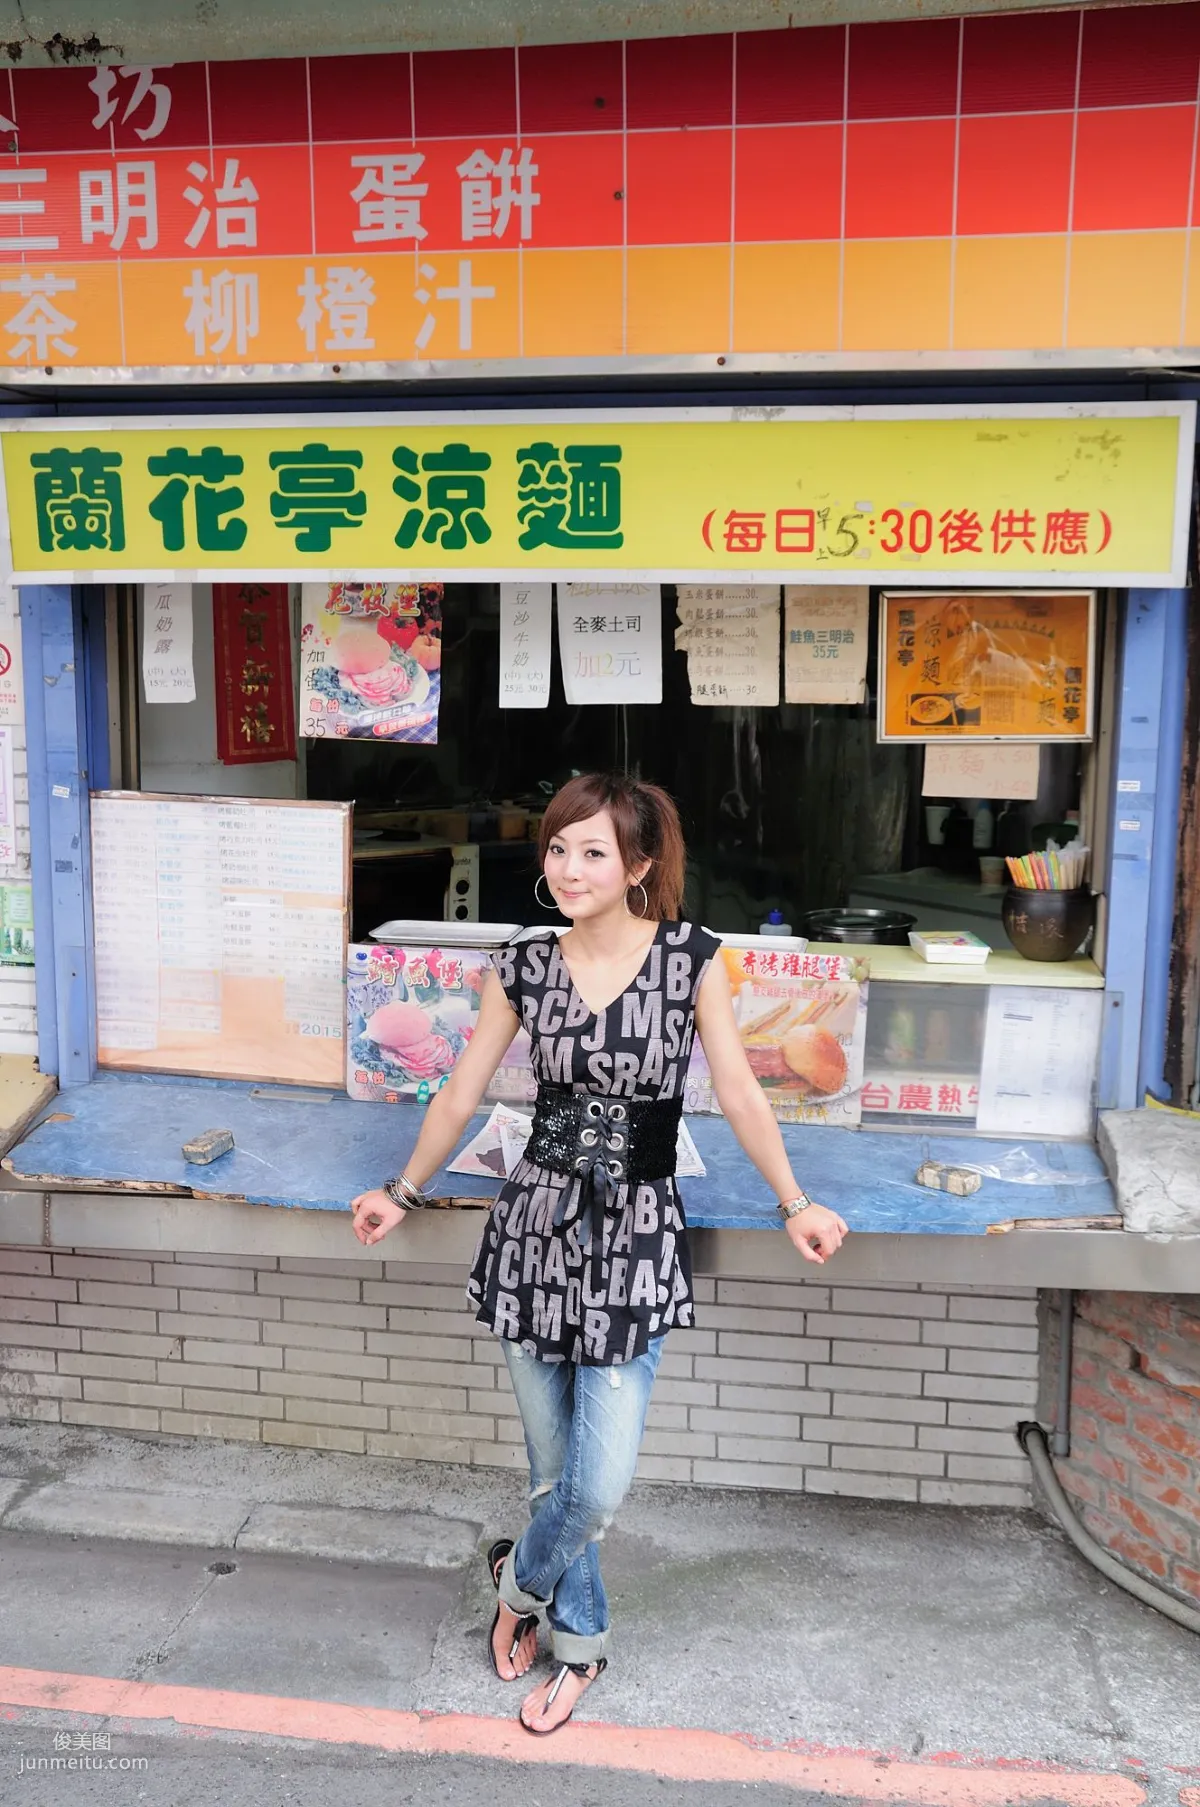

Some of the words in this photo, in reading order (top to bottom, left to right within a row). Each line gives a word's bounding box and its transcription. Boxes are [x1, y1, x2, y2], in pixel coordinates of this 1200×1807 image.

[0, 156, 259, 251] 三明治
[350, 148, 541, 243] 蛋餅
[0, 272, 79, 361] 茶
[182, 259, 496, 357] 柳橙汁
[30, 442, 624, 553] 蘭花亭涼麵
[511, 583, 532, 668] 豆沙牛奶
[573, 615, 641, 634] 全麥土司
[789, 629, 855, 645] 鮭魚三明治
[812, 644, 840, 659] 35元
[303, 717, 327, 737] 35
[335, 721, 350, 736] 元
[742, 951, 842, 982] 香烤雞腿堡
